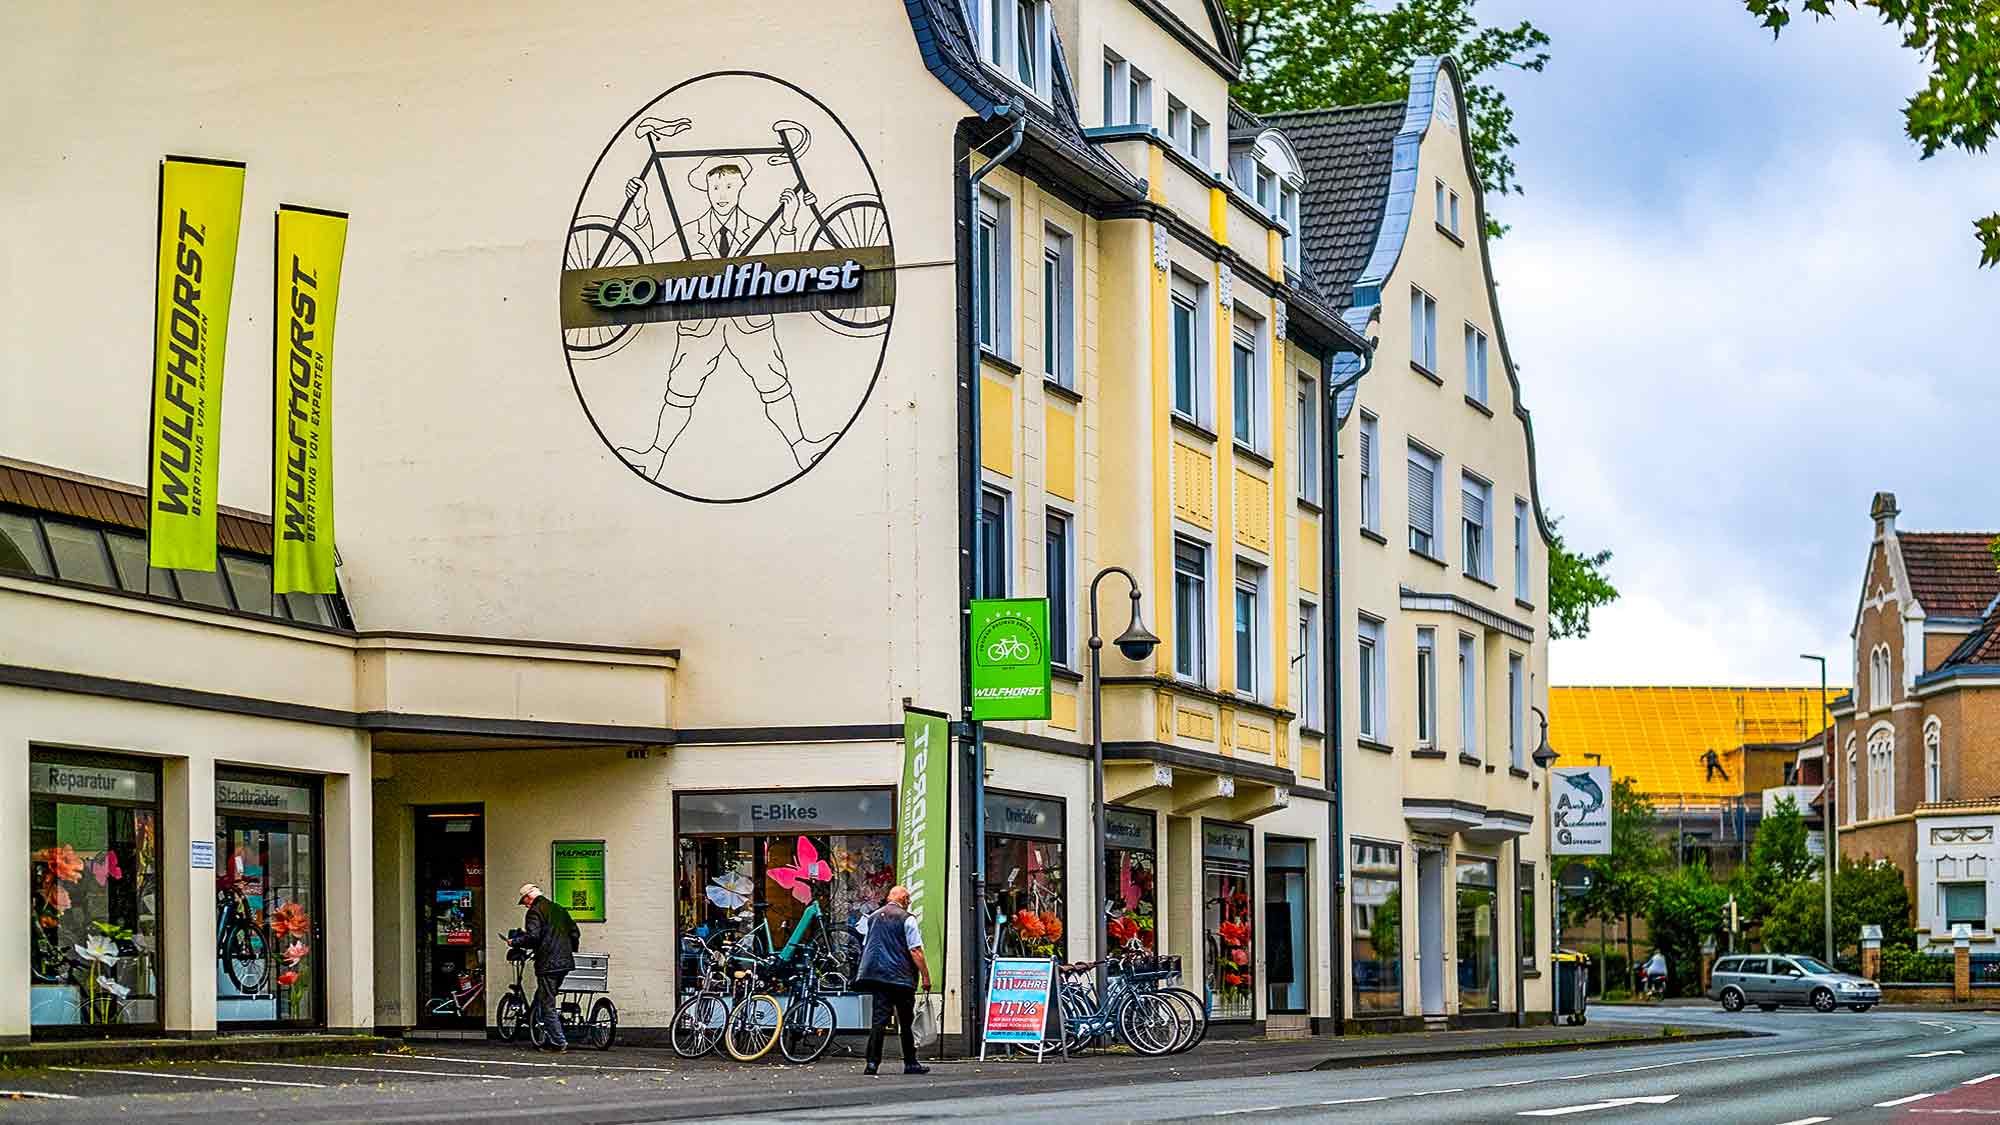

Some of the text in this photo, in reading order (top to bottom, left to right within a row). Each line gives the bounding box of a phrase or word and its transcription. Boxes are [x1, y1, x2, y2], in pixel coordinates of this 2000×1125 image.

[665, 260, 861, 302] wulfhorst
[158, 207, 204, 516] WULFHORST
[191, 313, 208, 517] BERATUNG VON EXPERTEN
[306, 351, 324, 542] BERATUNG VON EXPERTEN
[975, 686, 1044, 697] WULFHORST
[49, 767, 117, 792] Reparatur
[217, 785, 280, 806] Stadträder
[752, 804, 818, 820] E-Bikes
[996, 977, 1048, 990] 111 JAHRE
[999, 1000, 1037, 1017] 11,1%
